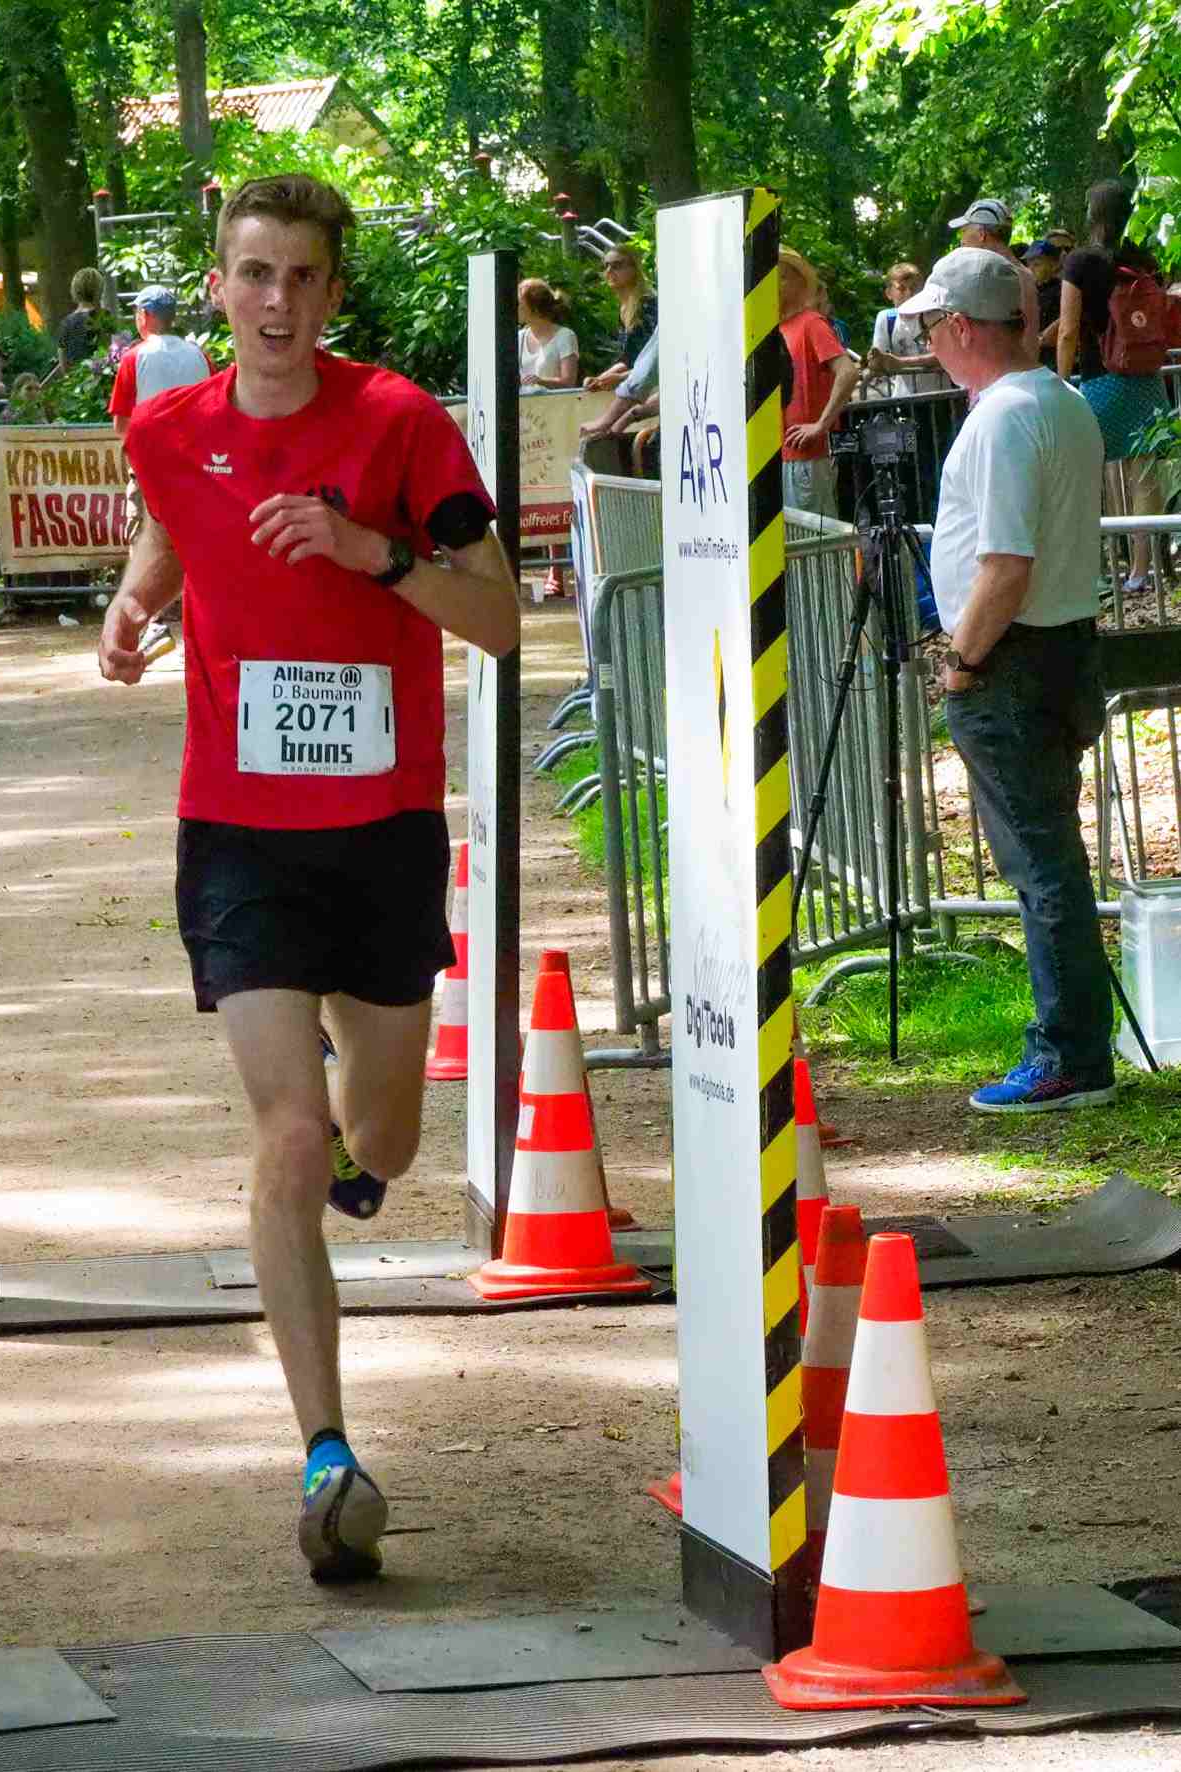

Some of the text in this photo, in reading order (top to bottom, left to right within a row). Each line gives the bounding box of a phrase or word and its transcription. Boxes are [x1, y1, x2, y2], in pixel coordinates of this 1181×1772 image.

[274, 666, 336, 683] Allianz
[273, 684, 362, 701] D. Baumann
[275, 702, 356, 732] 2071
[281, 735, 353, 764] bruns
[686, 994, 735, 1049] DigiTools
